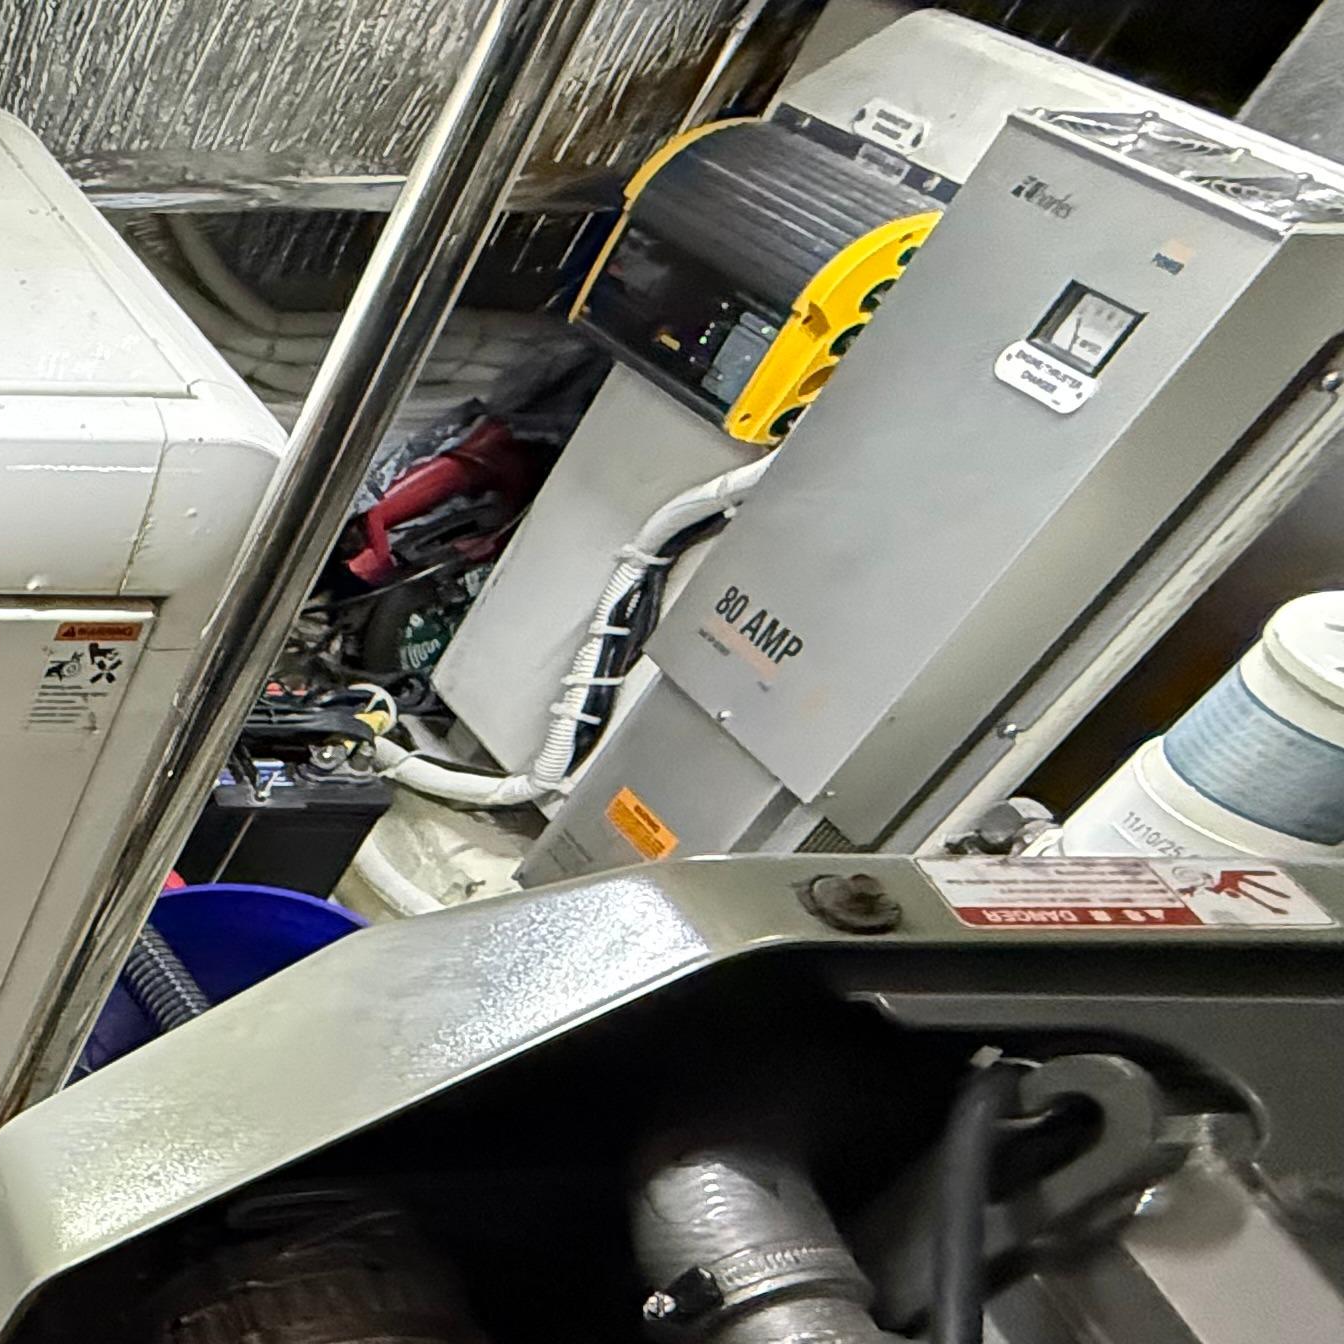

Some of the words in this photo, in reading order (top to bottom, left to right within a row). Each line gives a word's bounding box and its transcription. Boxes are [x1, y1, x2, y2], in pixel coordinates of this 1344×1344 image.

[715, 585, 750, 624] 80
[740, 609, 803, 664] AMP
[981, 909, 1079, 922] DANGER
